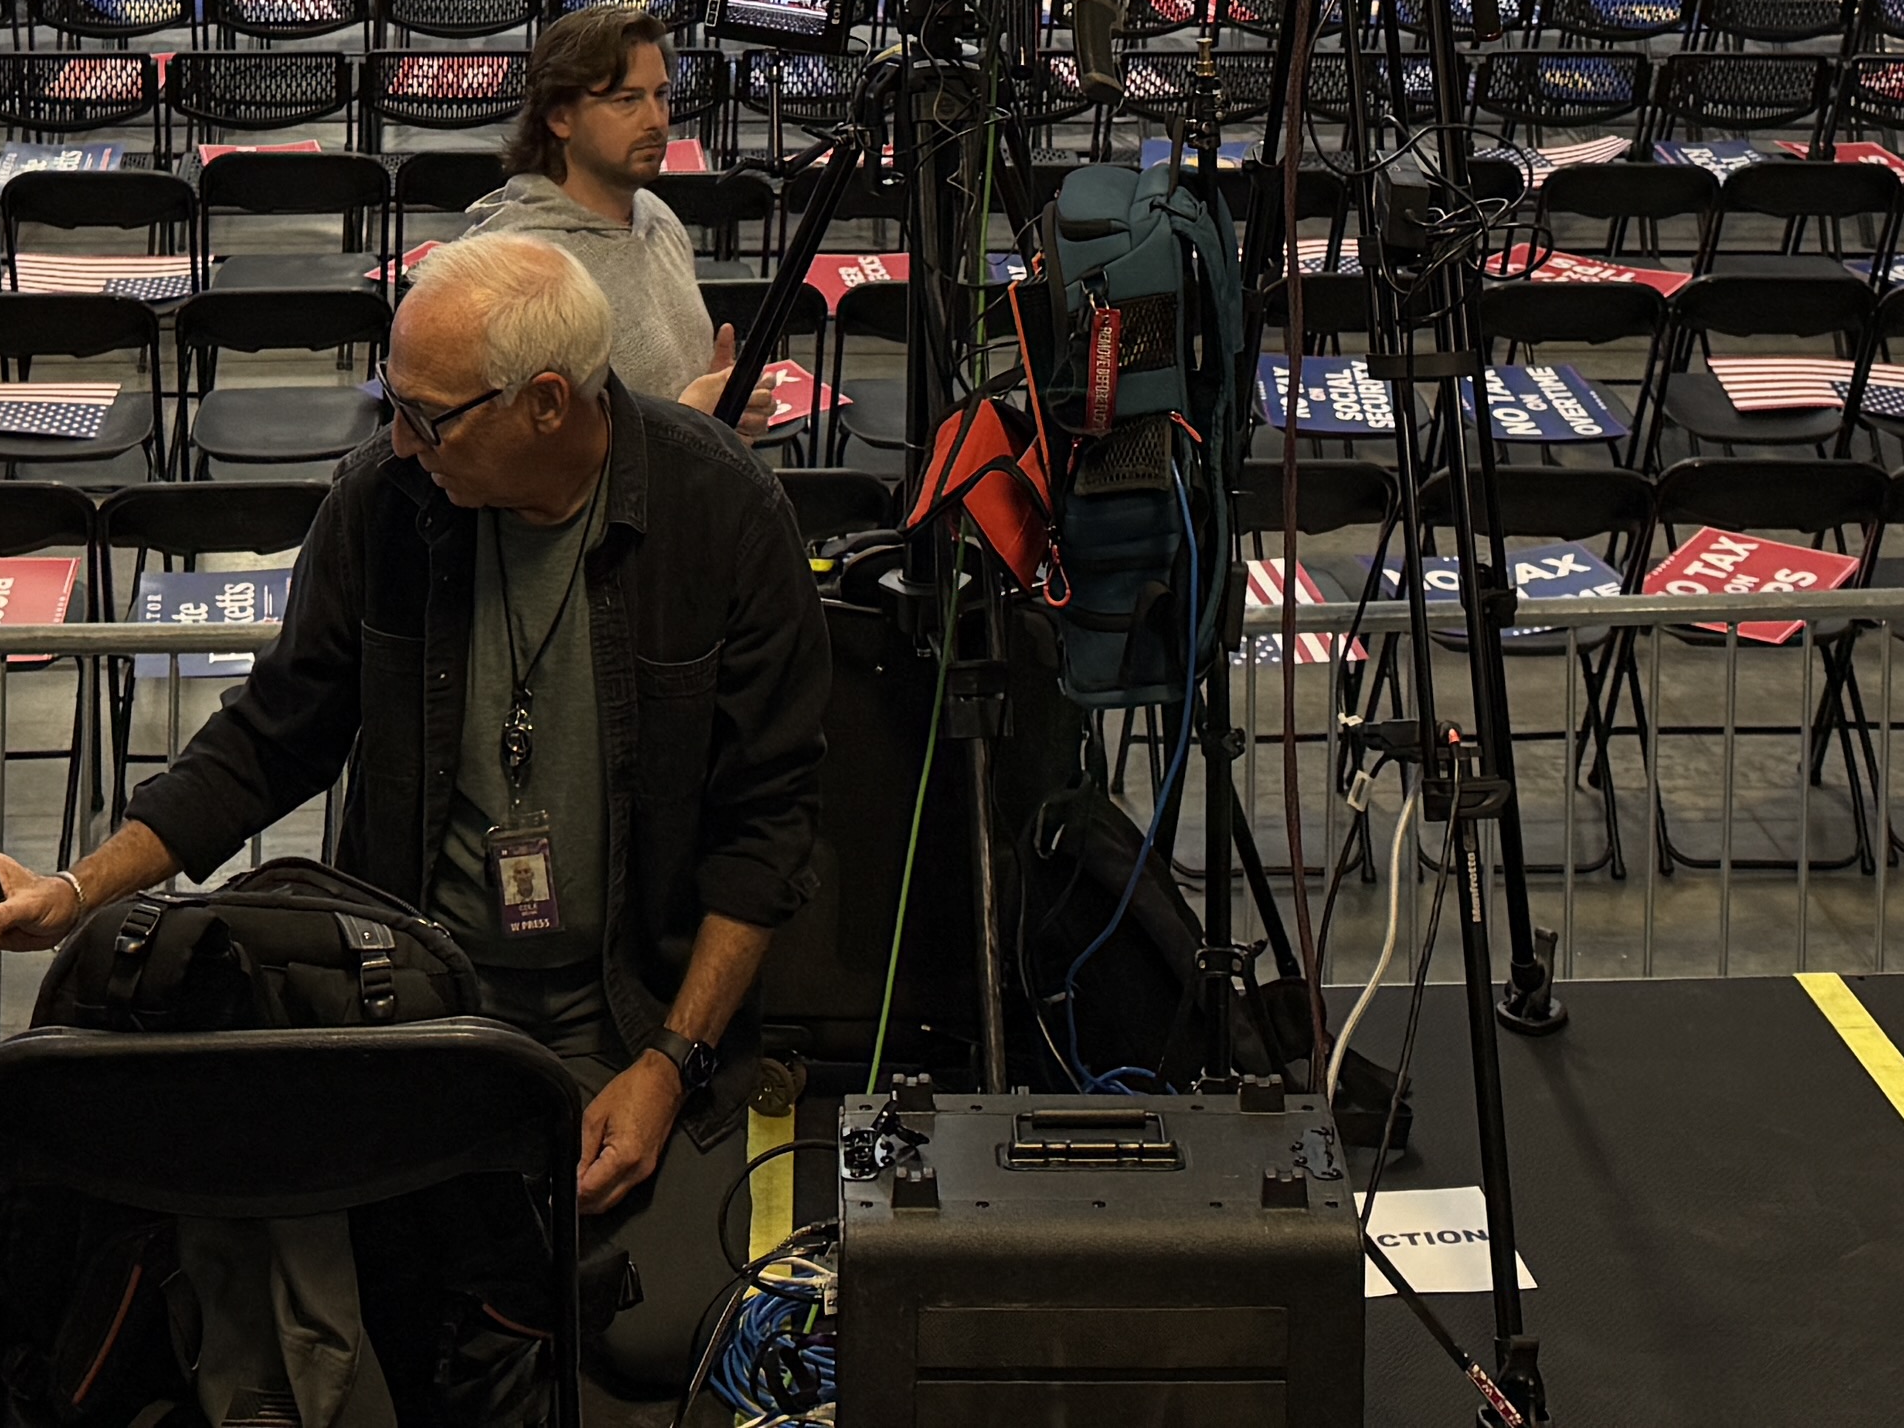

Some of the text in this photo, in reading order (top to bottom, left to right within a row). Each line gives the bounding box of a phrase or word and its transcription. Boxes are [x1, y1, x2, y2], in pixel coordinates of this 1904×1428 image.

[1097, 327, 1113, 367] REMOVE
[1325, 367, 1363, 421] SOCIAL
[1520, 394, 1548, 412] ON
[1526, 366, 1603, 435] OVERTIME
[1492, 407, 1543, 436] NO
[1684, 536, 1760, 578] TAX
[1723, 574, 1760, 594] ON
[1467, 852, 1482, 923] Manfrotto
